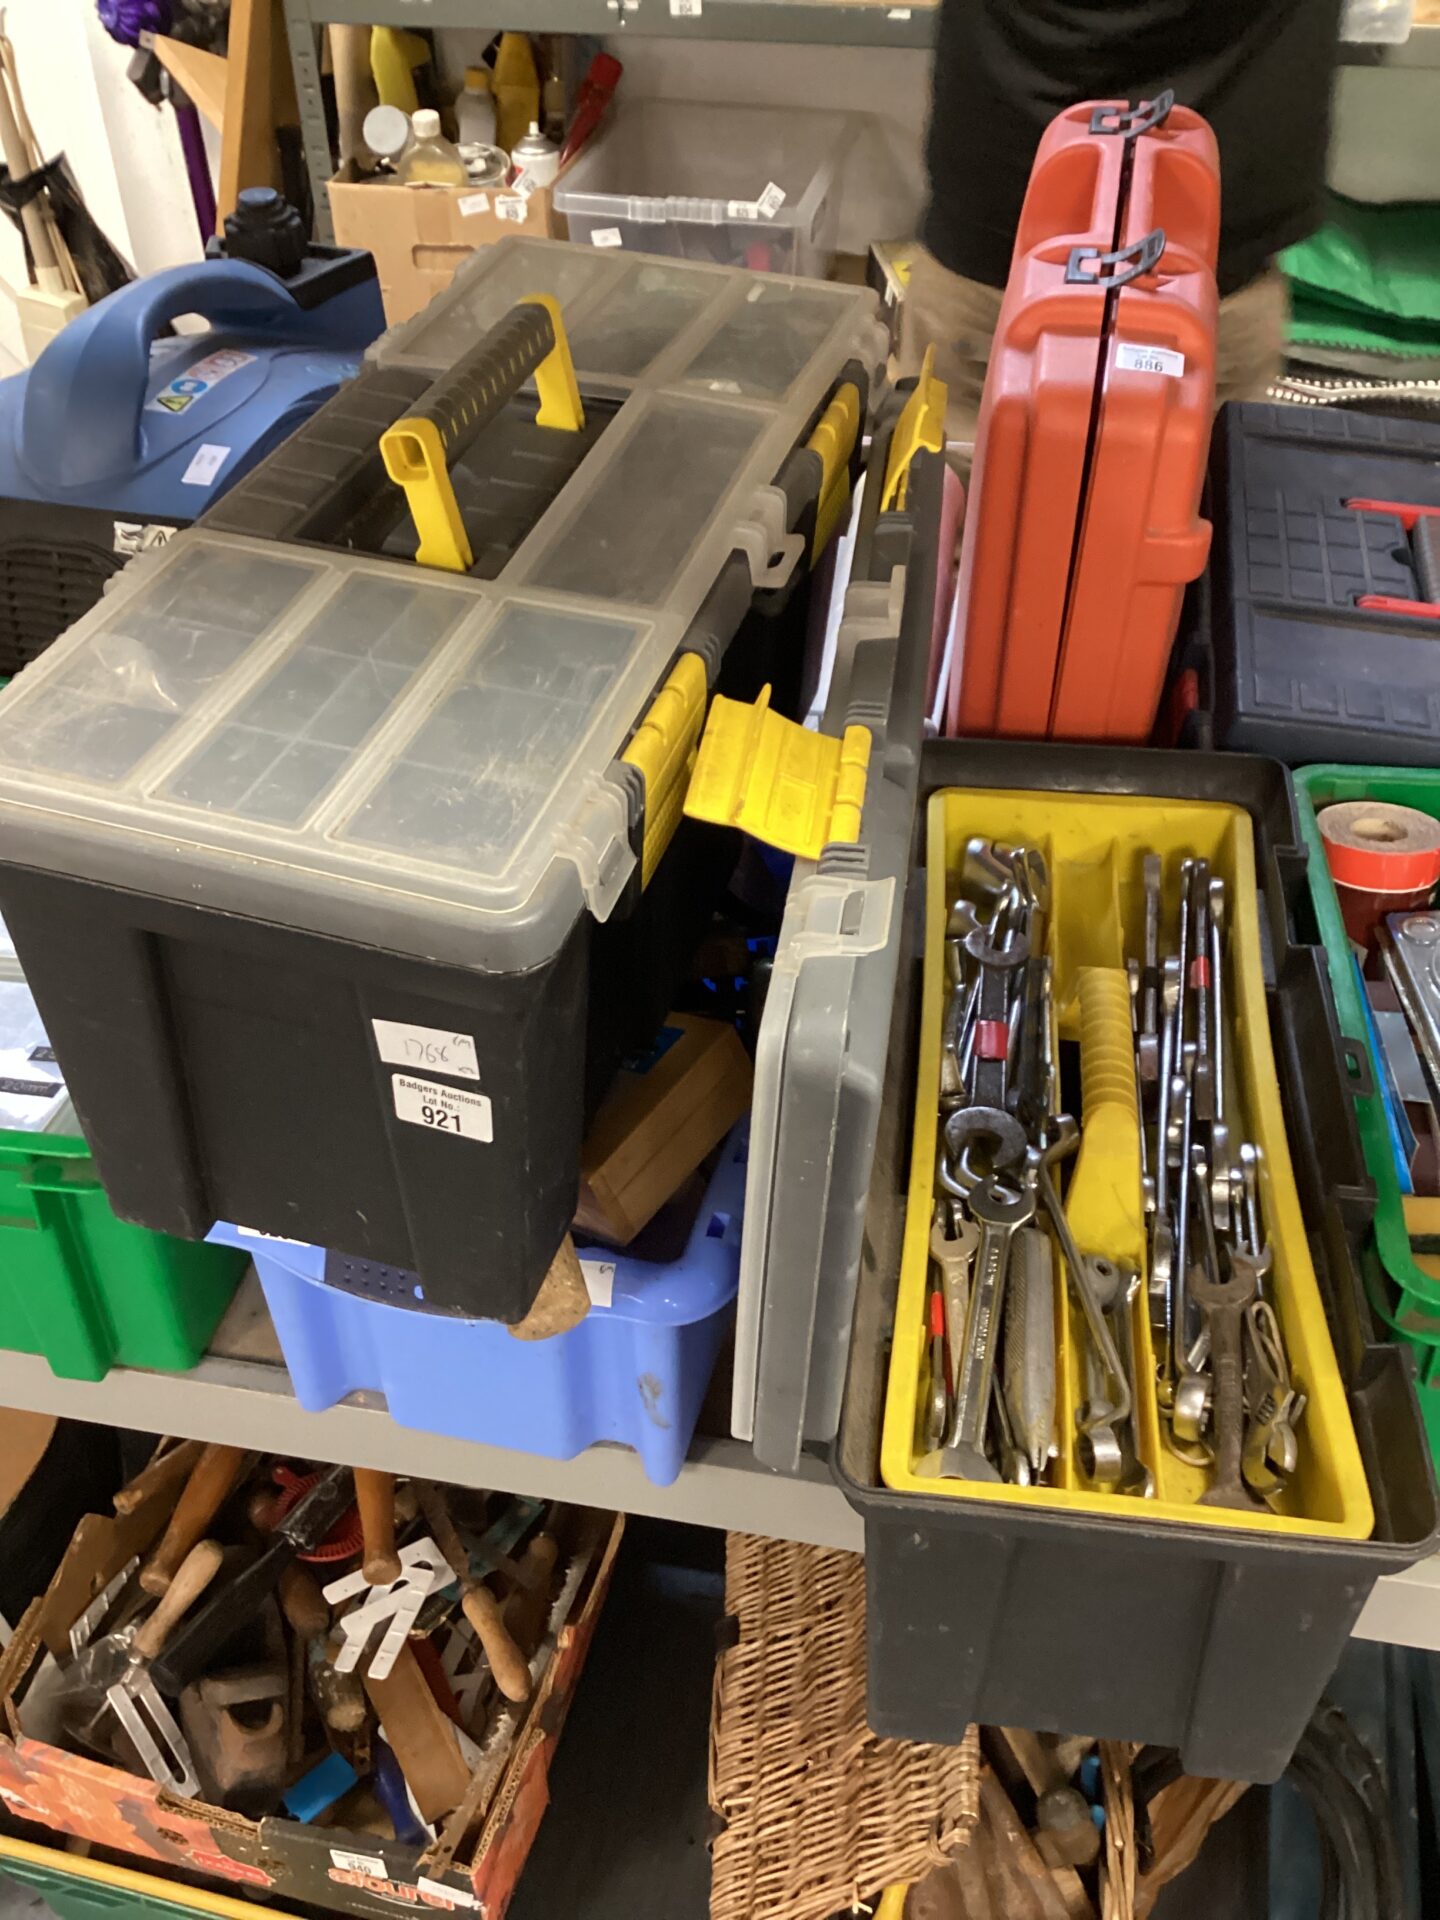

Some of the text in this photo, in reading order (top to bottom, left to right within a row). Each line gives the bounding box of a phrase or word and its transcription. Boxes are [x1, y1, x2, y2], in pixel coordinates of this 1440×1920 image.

[1134, 358, 1164, 373] 886
[399, 1078, 482, 1107] Badgers Auctions
[422, 1095, 438, 1106] Lot
[421, 1105, 462, 1133] 921
